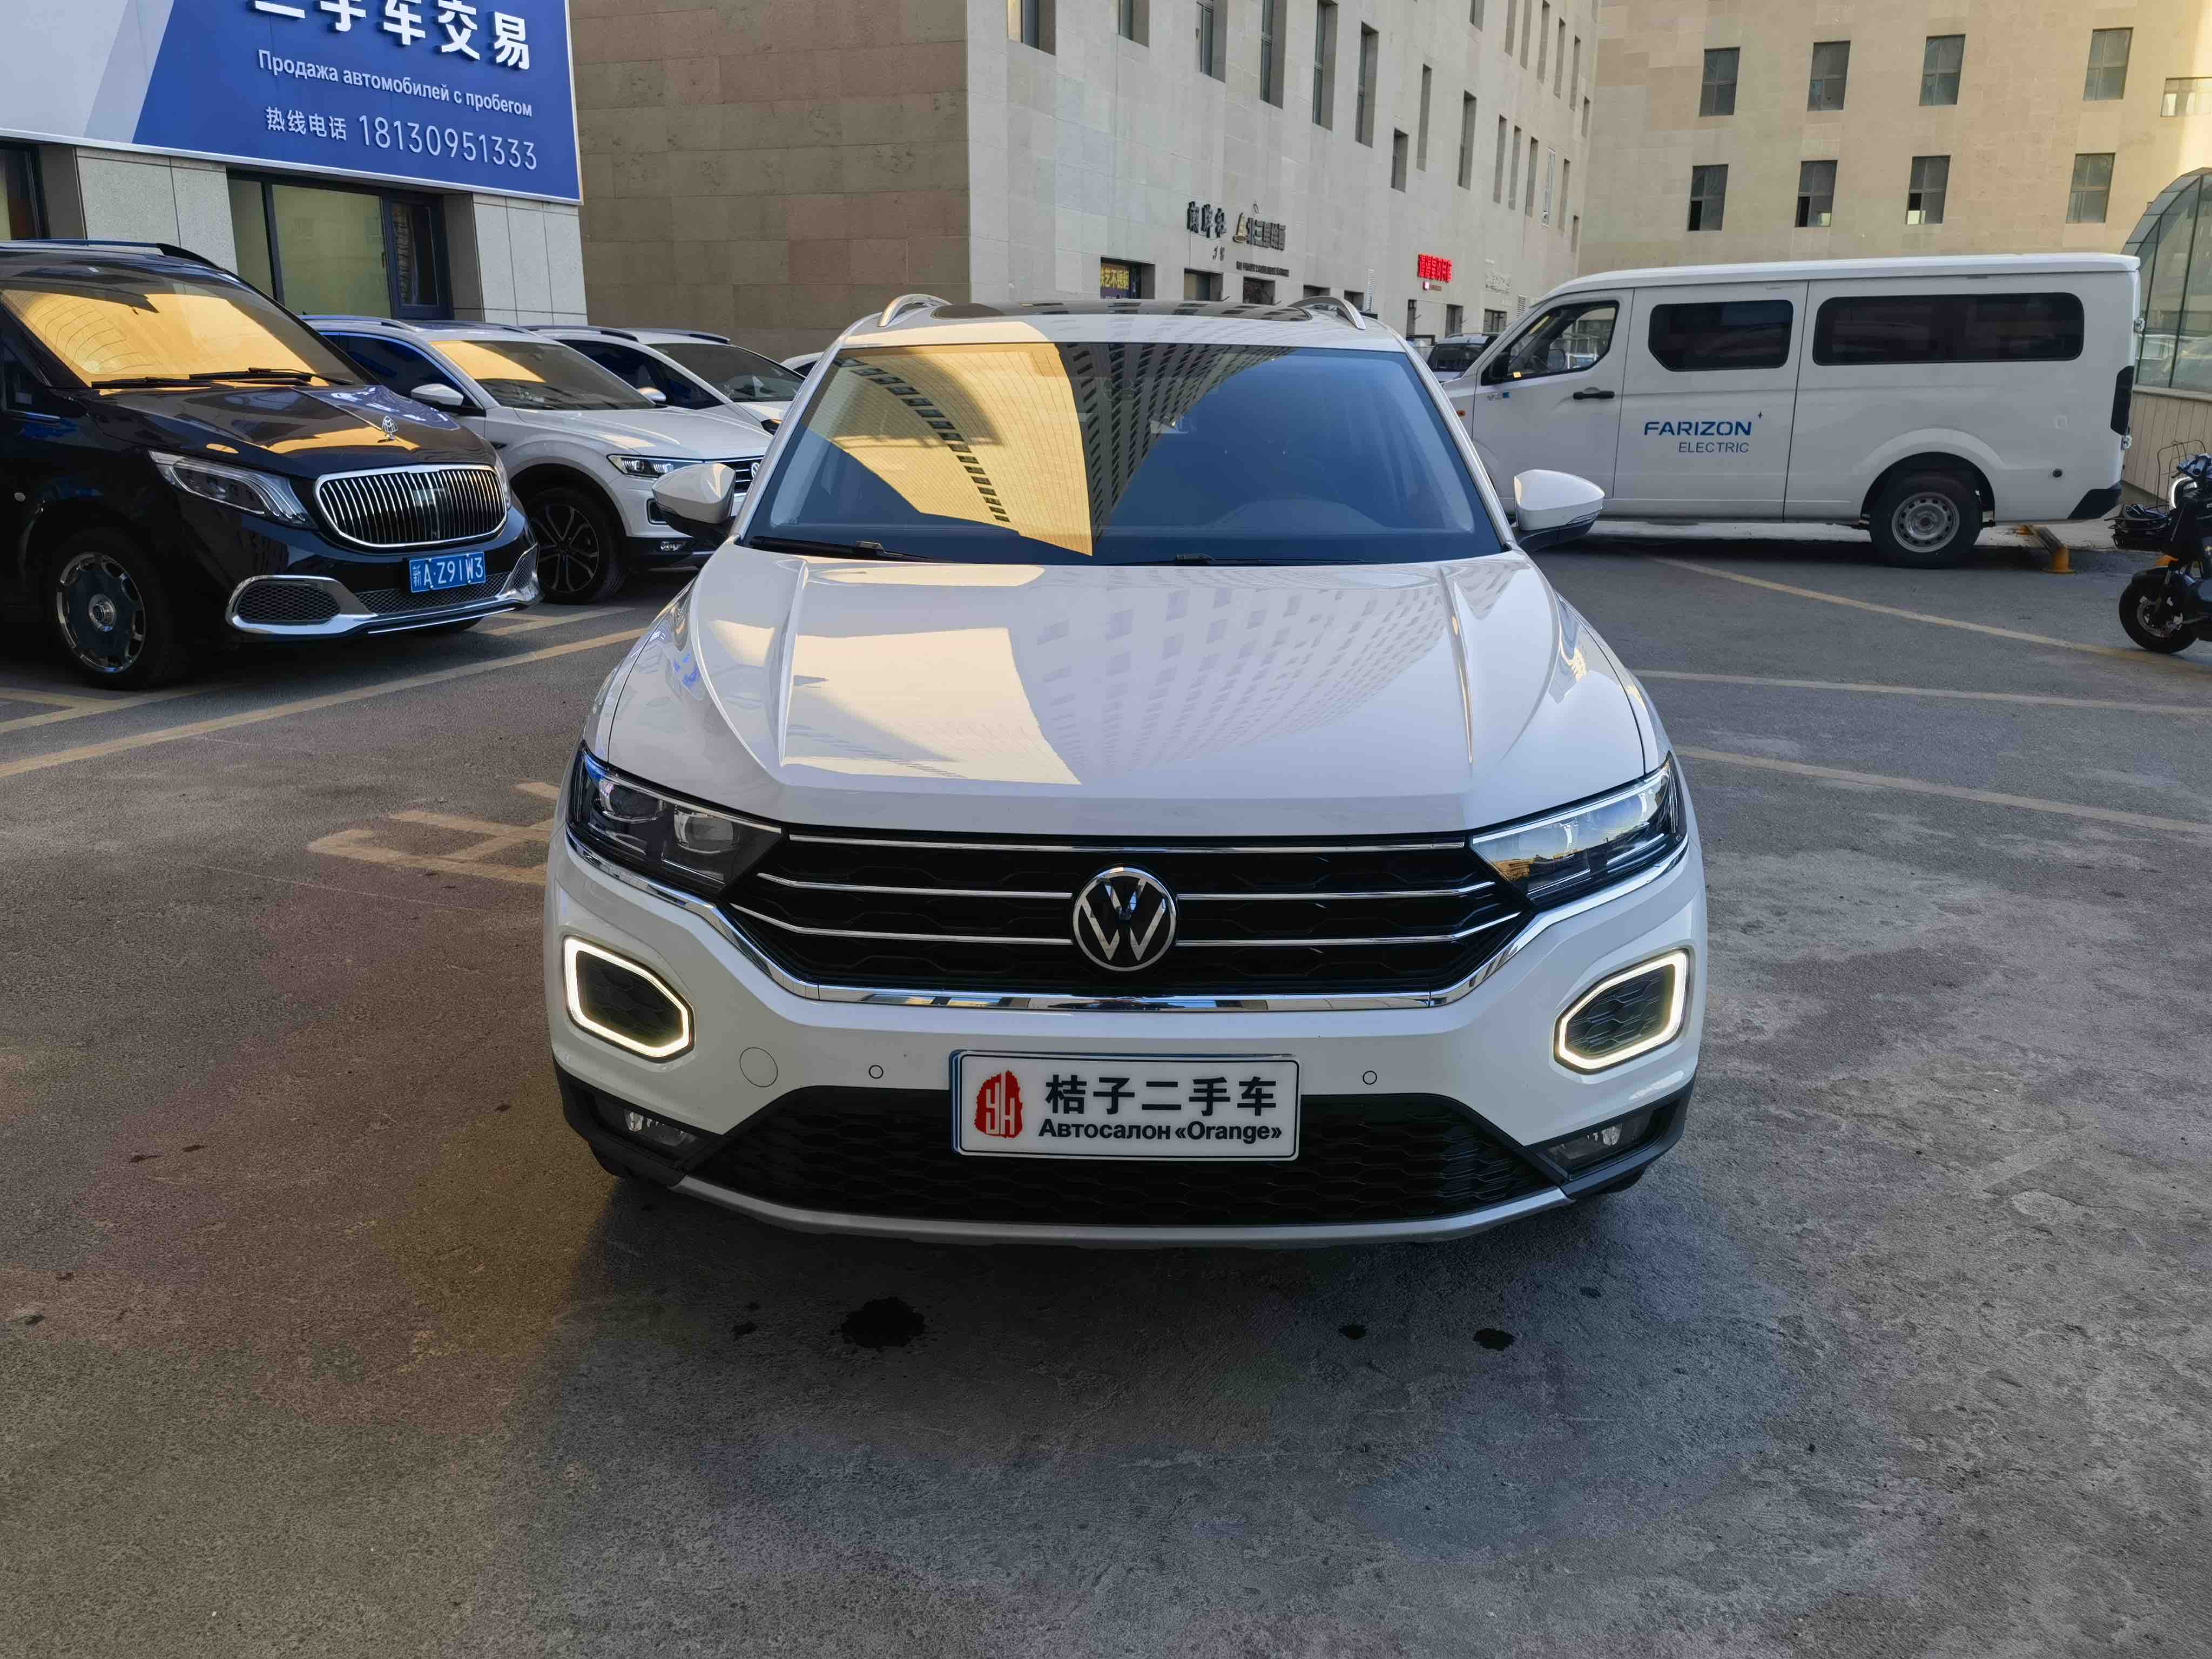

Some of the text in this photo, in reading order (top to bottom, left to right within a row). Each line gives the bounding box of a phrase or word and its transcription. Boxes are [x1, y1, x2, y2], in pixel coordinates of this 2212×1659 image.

[258, 49, 532, 117] Продажа автомобилей с пробегом
[266, 106, 538, 171] 热线电话 18130951333
[1643, 421, 1752, 436] FARIZON
[1678, 441, 1750, 453] ELECTRIC
[1045, 1074, 1277, 1116] 桔子二手车
